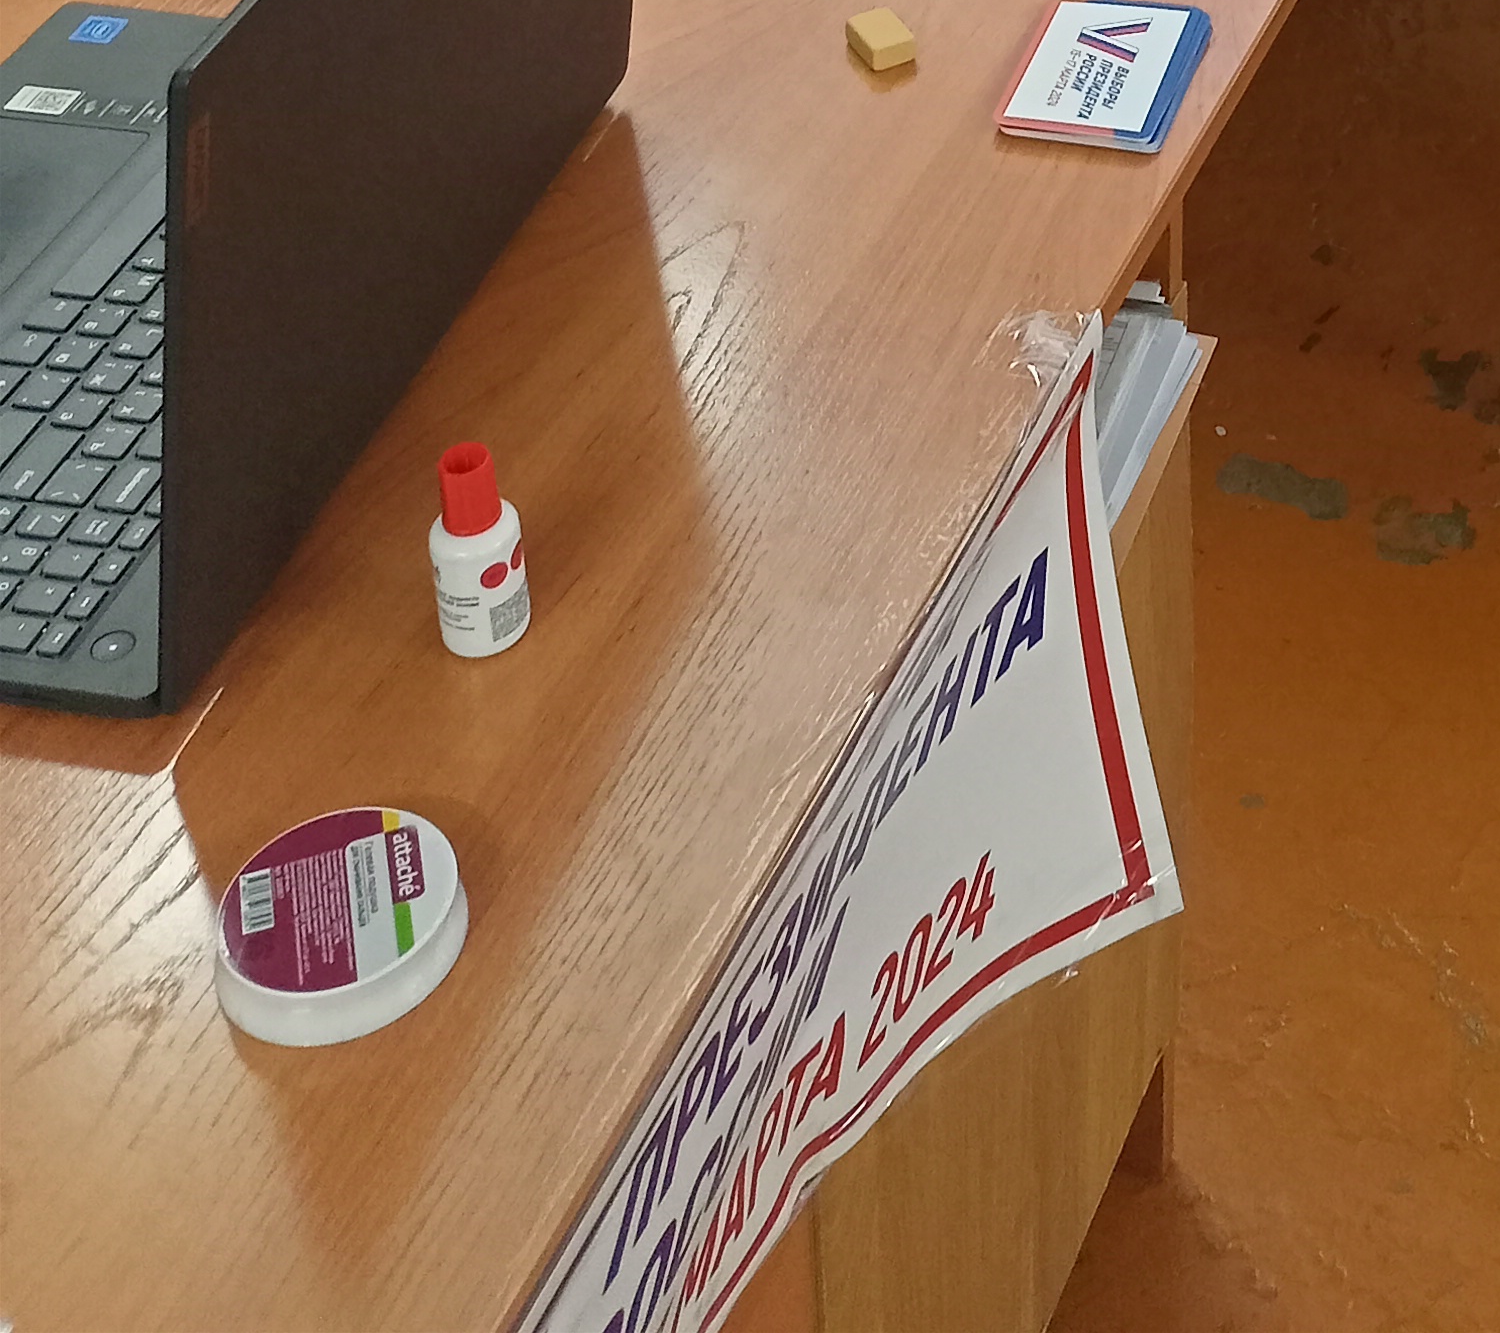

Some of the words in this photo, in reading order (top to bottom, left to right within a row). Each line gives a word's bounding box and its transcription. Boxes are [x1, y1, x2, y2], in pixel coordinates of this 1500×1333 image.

[1071, 52, 1098, 93] РОССИИ
[1077, 59, 1114, 120] ПРЕЗИДЕНТА
[1102, 65, 1130, 110] ВЫБОРЫ
[392, 831, 421, 897] attaché
[602, 546, 1049, 1296] ПРЕЗИДЕНТА
[602, 896, 850, 1333] ОССИИ
[671, 1010, 846, 1333] МАРТА
[857, 849, 996, 1073] 2024
